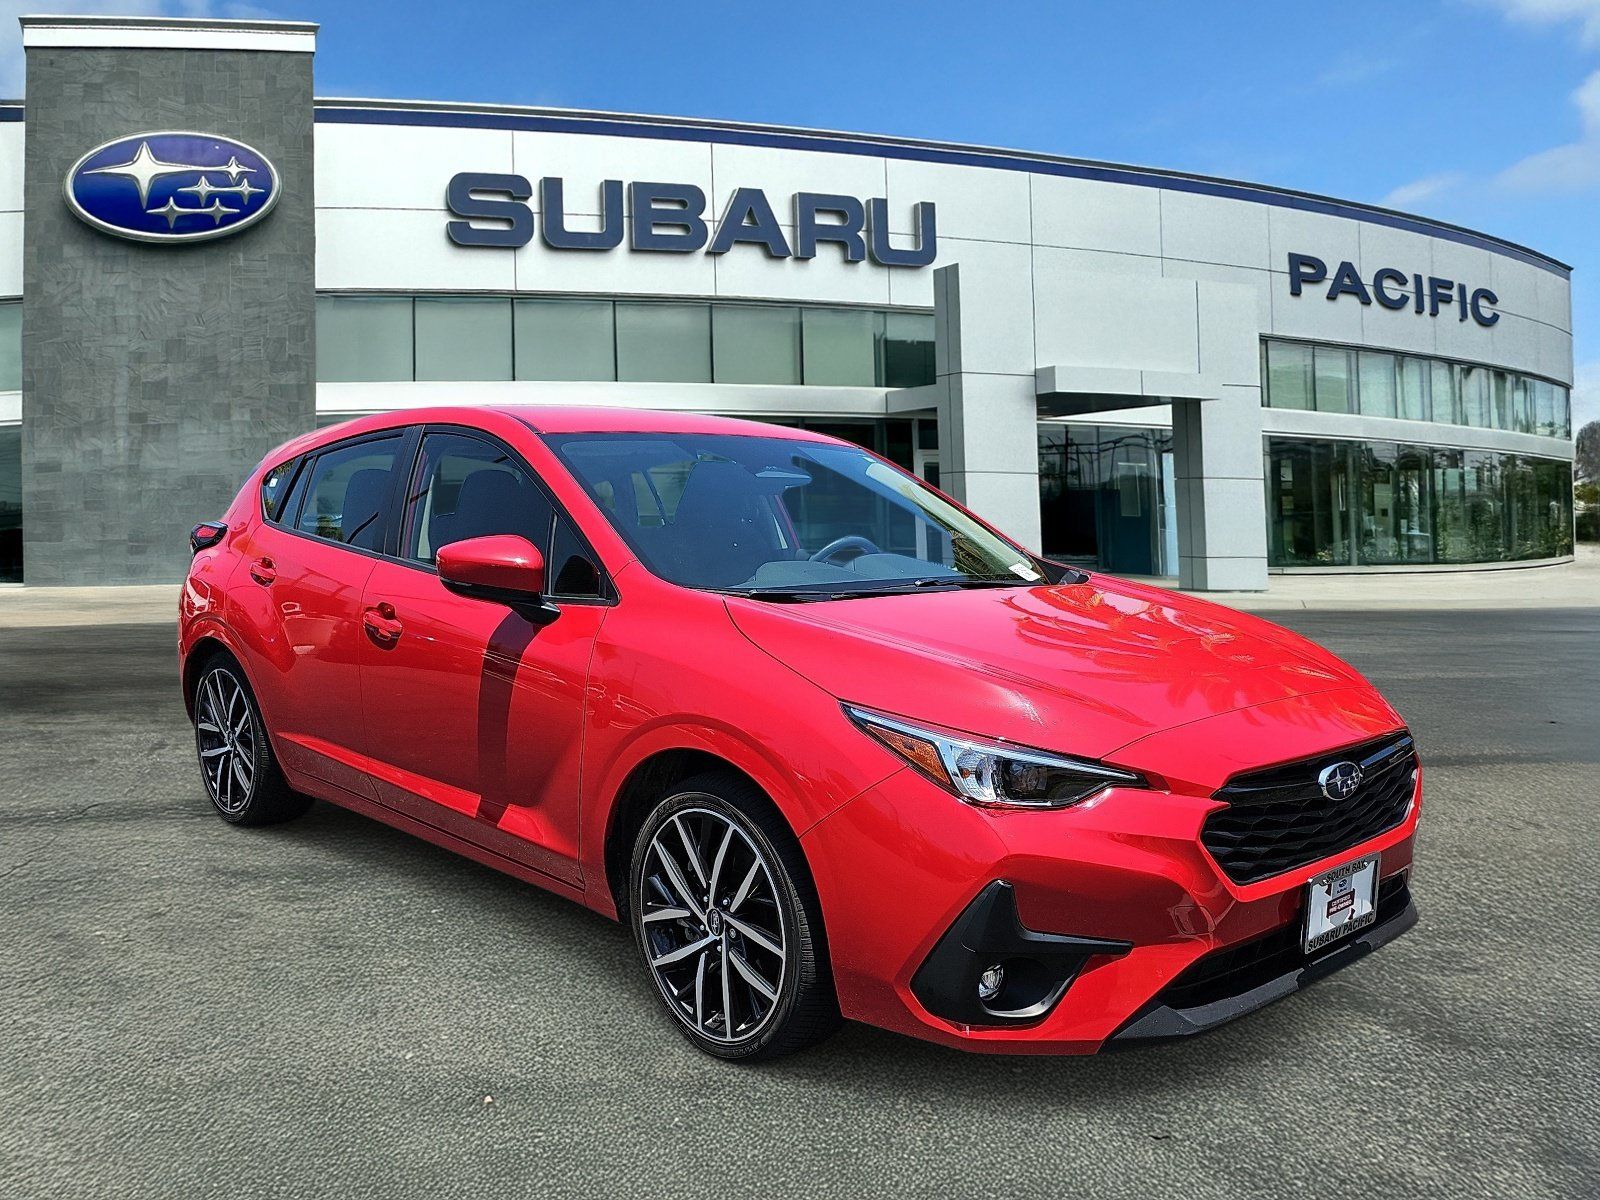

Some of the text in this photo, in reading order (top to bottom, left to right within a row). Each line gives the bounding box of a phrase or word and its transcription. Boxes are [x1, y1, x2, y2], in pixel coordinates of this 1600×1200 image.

[447, 171, 937, 267] SUBARU
[1288, 252, 1500, 327] PACIFIC
[1326, 860, 1367, 881] SOUTH BAY
[1308, 913, 1374, 951] SUBARU PACIFIC
